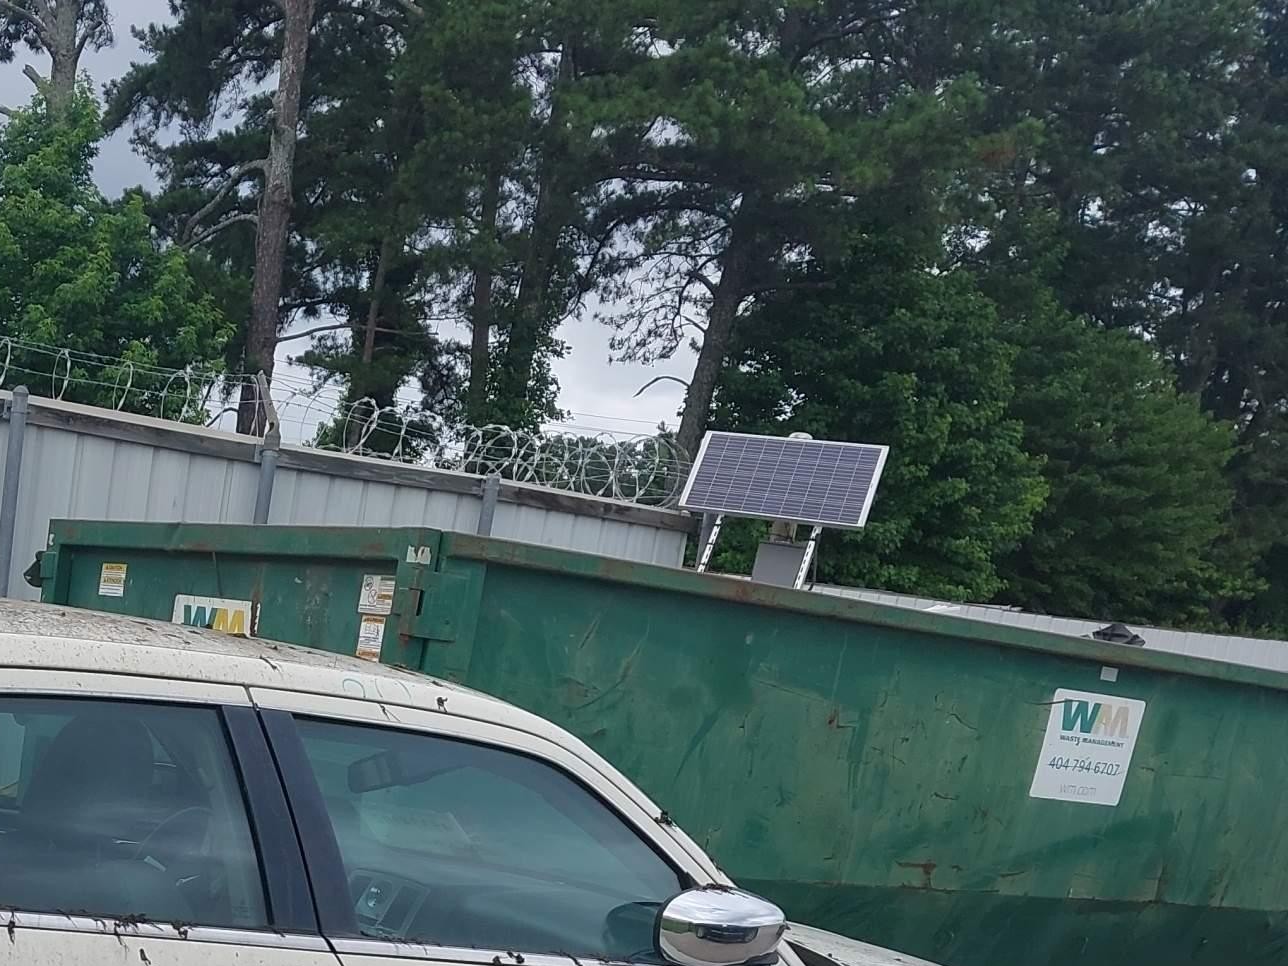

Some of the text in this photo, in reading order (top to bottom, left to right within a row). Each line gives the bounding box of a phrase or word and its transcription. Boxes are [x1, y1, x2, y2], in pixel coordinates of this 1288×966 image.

[184, 604, 244, 633] WM
[1061, 698, 1130, 739] WM
[1059, 735, 1125, 748] WASTE MANAGEMENT
[1049, 756, 1121, 776] 404 794 6707
